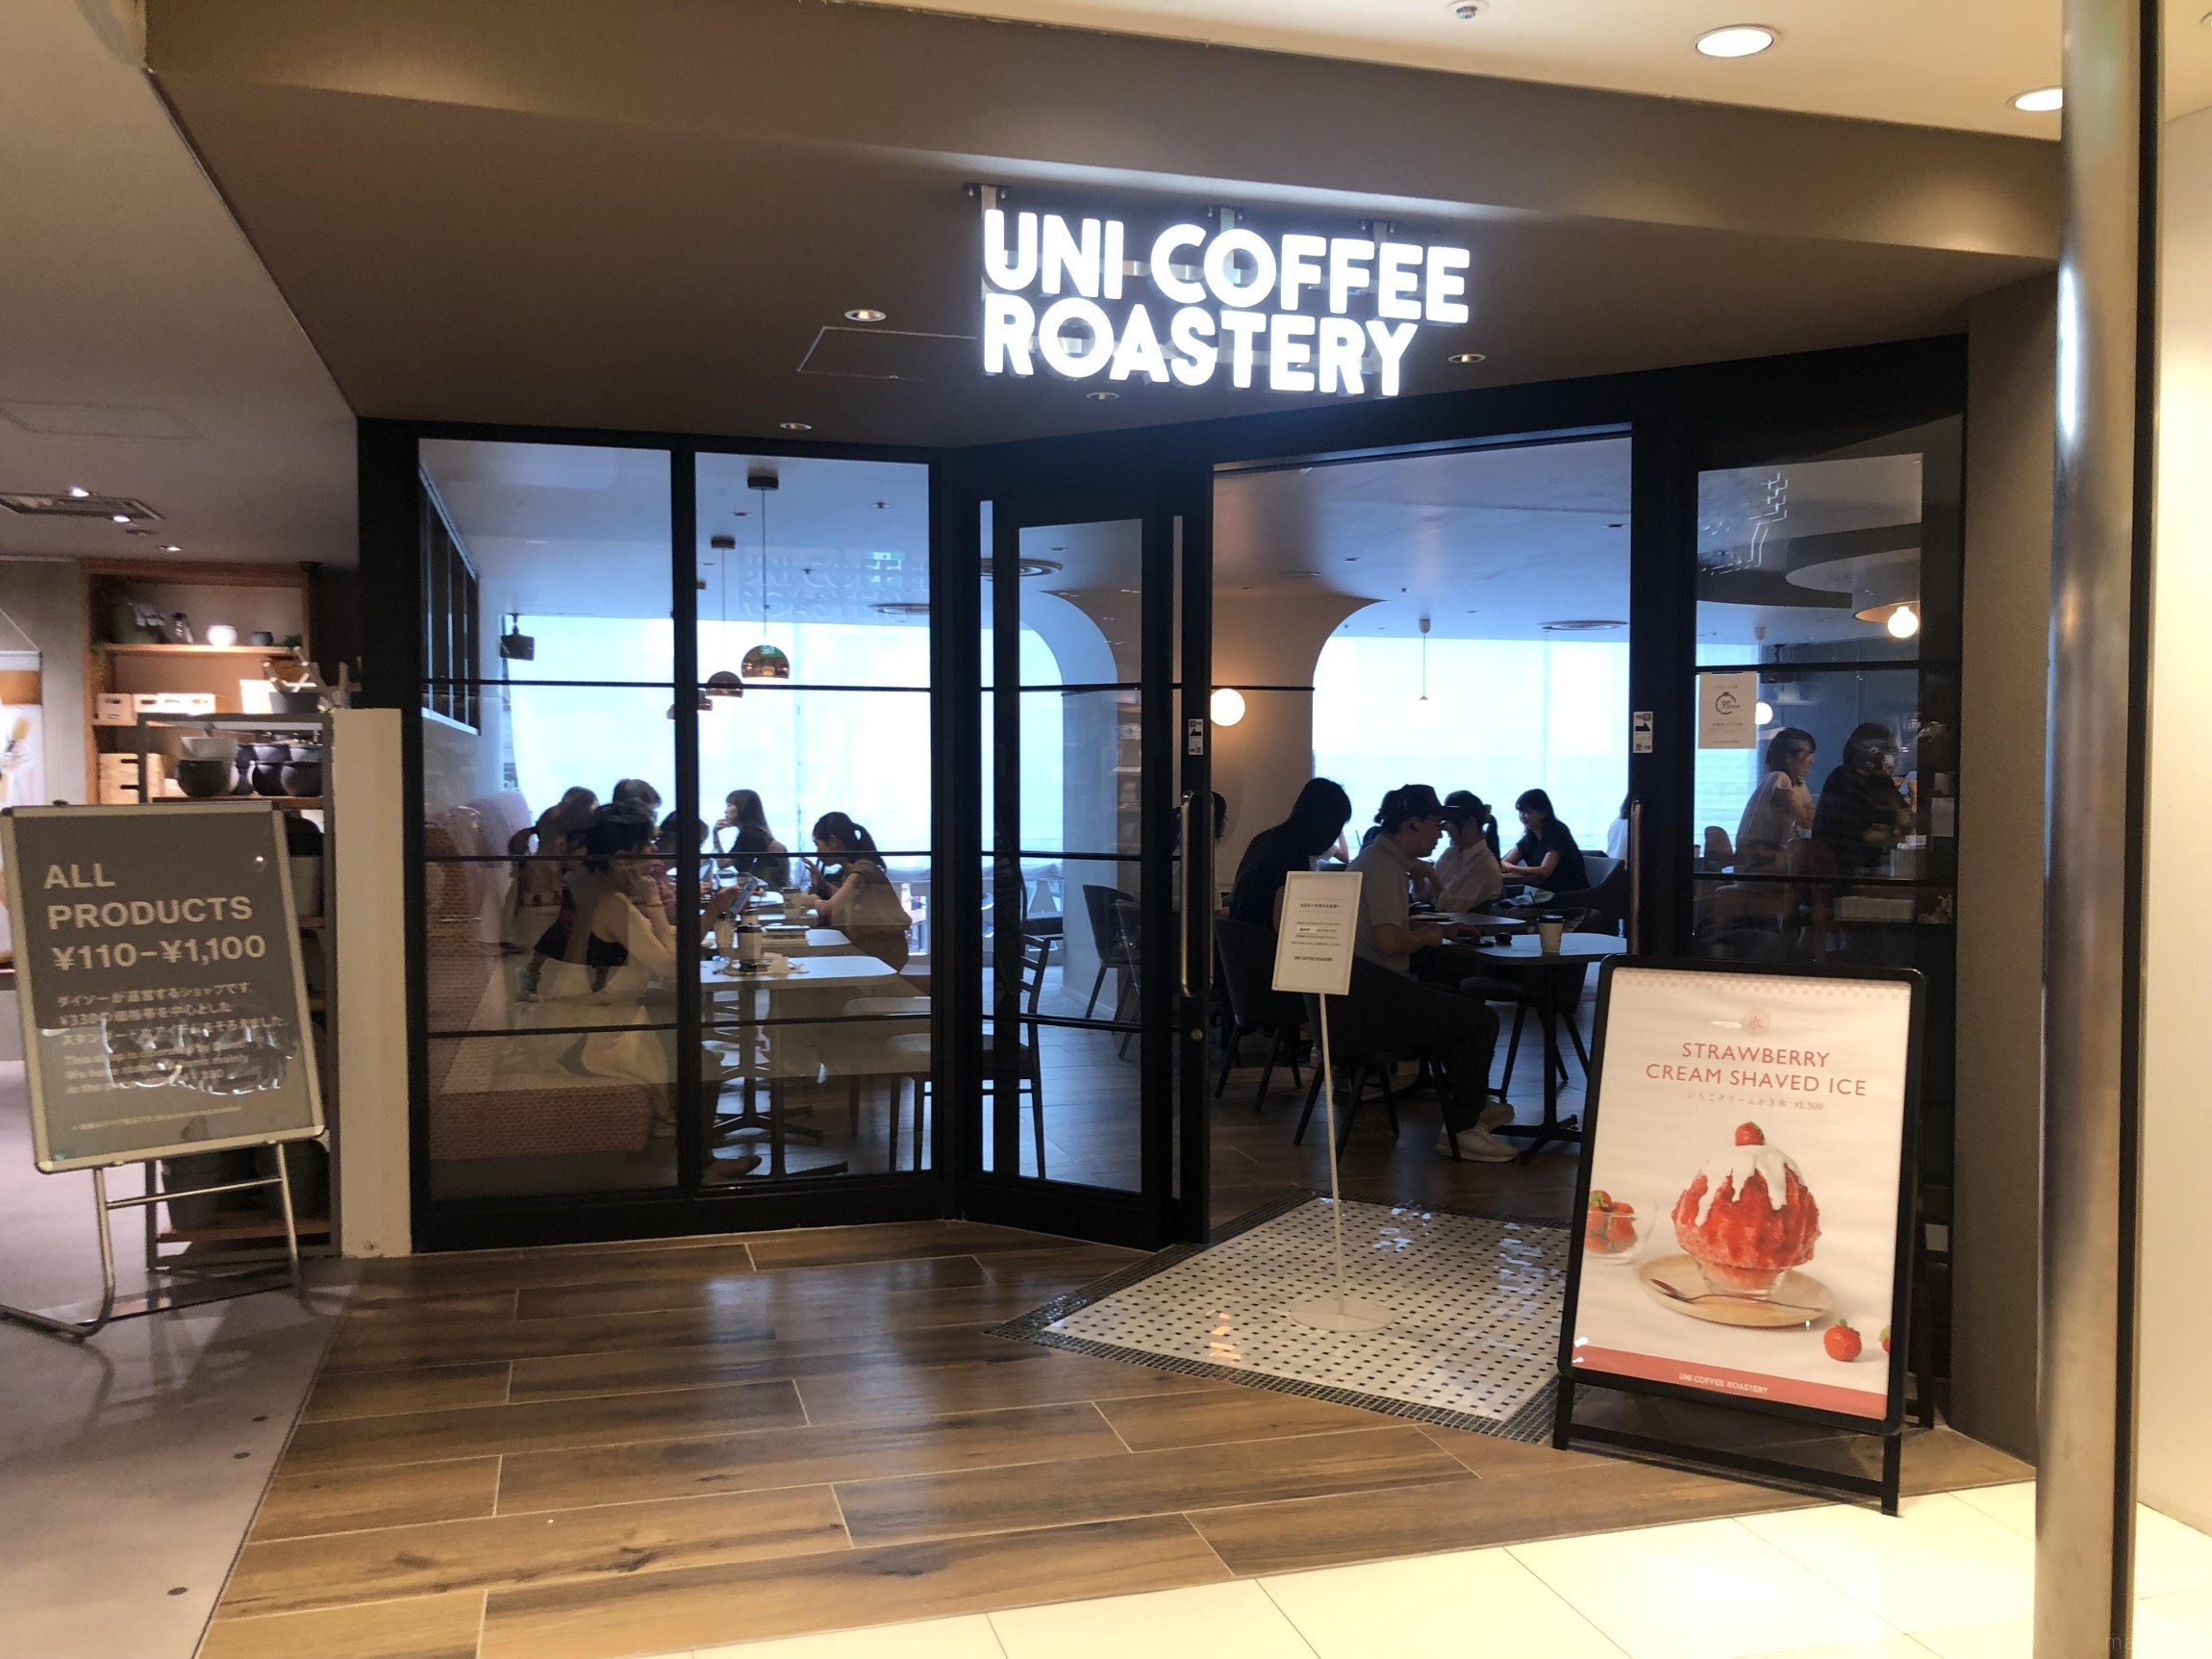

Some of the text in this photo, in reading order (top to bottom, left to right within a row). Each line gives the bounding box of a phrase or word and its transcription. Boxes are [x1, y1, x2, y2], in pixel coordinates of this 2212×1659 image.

[983, 209, 1470, 324] UNI COFFEE
[983, 293, 1419, 397] ROASTERY
[43, 863, 116, 890] ALL
[47, 895, 254, 930] PRODUCTS
[1681, 1042, 1830, 1068] STRAWBERRY
[1646, 1063, 1867, 1096] CREAM SHAVED ICE
[1694, 1375, 1724, 1387] COFFEE
[1726, 1381, 1769, 1395] ROASTERY
